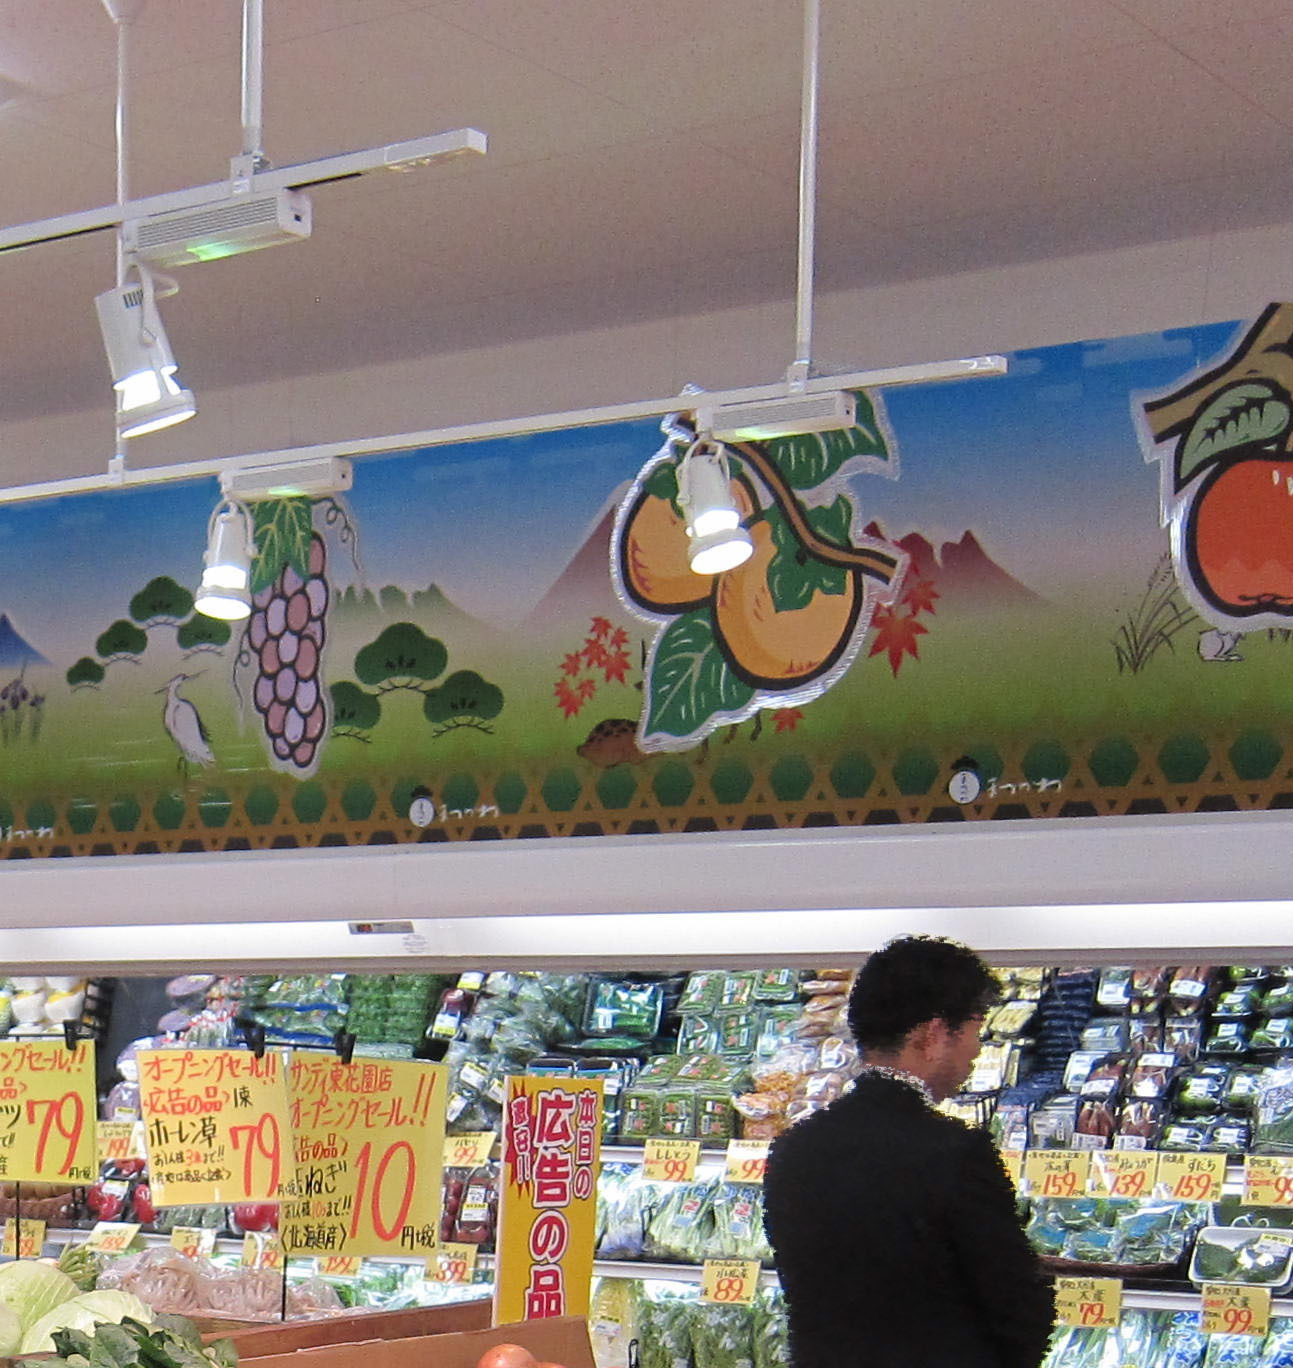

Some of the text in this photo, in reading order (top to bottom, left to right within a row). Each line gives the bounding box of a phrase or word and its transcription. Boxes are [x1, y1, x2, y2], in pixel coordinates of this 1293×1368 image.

[143, 1052, 277, 1085] オープニングセール!!
[290, 1072, 436, 1129] オープニングセール!!
[26, 1091, 84, 1175] 79
[573, 1089, 599, 1200] 本日の
[229, 1113, 280, 1198] 79
[452, 1146, 477, 1165] 99
[656, 1149, 691, 1160] ししとう
[664, 1160, 687, 1181] 99
[742, 1159, 769, 1179] 99
[350, 1141, 416, 1242] 10
[1042, 1172, 1076, 1196] 159
[1111, 1171, 1146, 1196] 139
[1173, 1173, 1212, 1198] 159
[523, 1088, 577, 1322] 広告の品
[714, 1278, 743, 1301] 89
[1080, 1303, 1104, 1325] 79
[1224, 1308, 1252, 1333] 99
